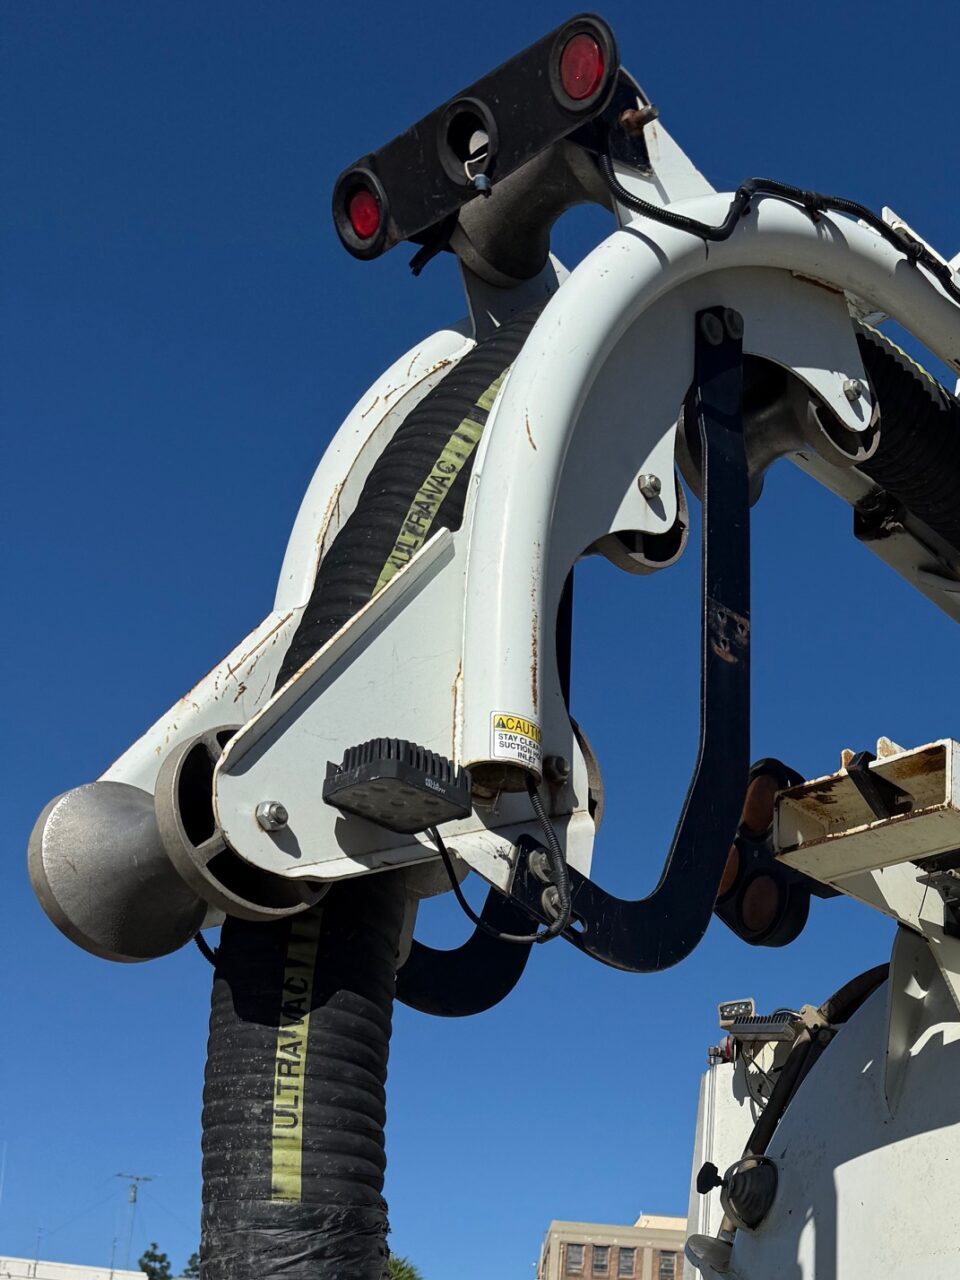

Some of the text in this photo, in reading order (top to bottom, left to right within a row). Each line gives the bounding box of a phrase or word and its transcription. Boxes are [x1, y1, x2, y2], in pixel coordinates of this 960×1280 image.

[498, 733, 518, 742] STAY
[499, 741, 532, 755] SUCTION
[517, 752, 535, 764] INLET
